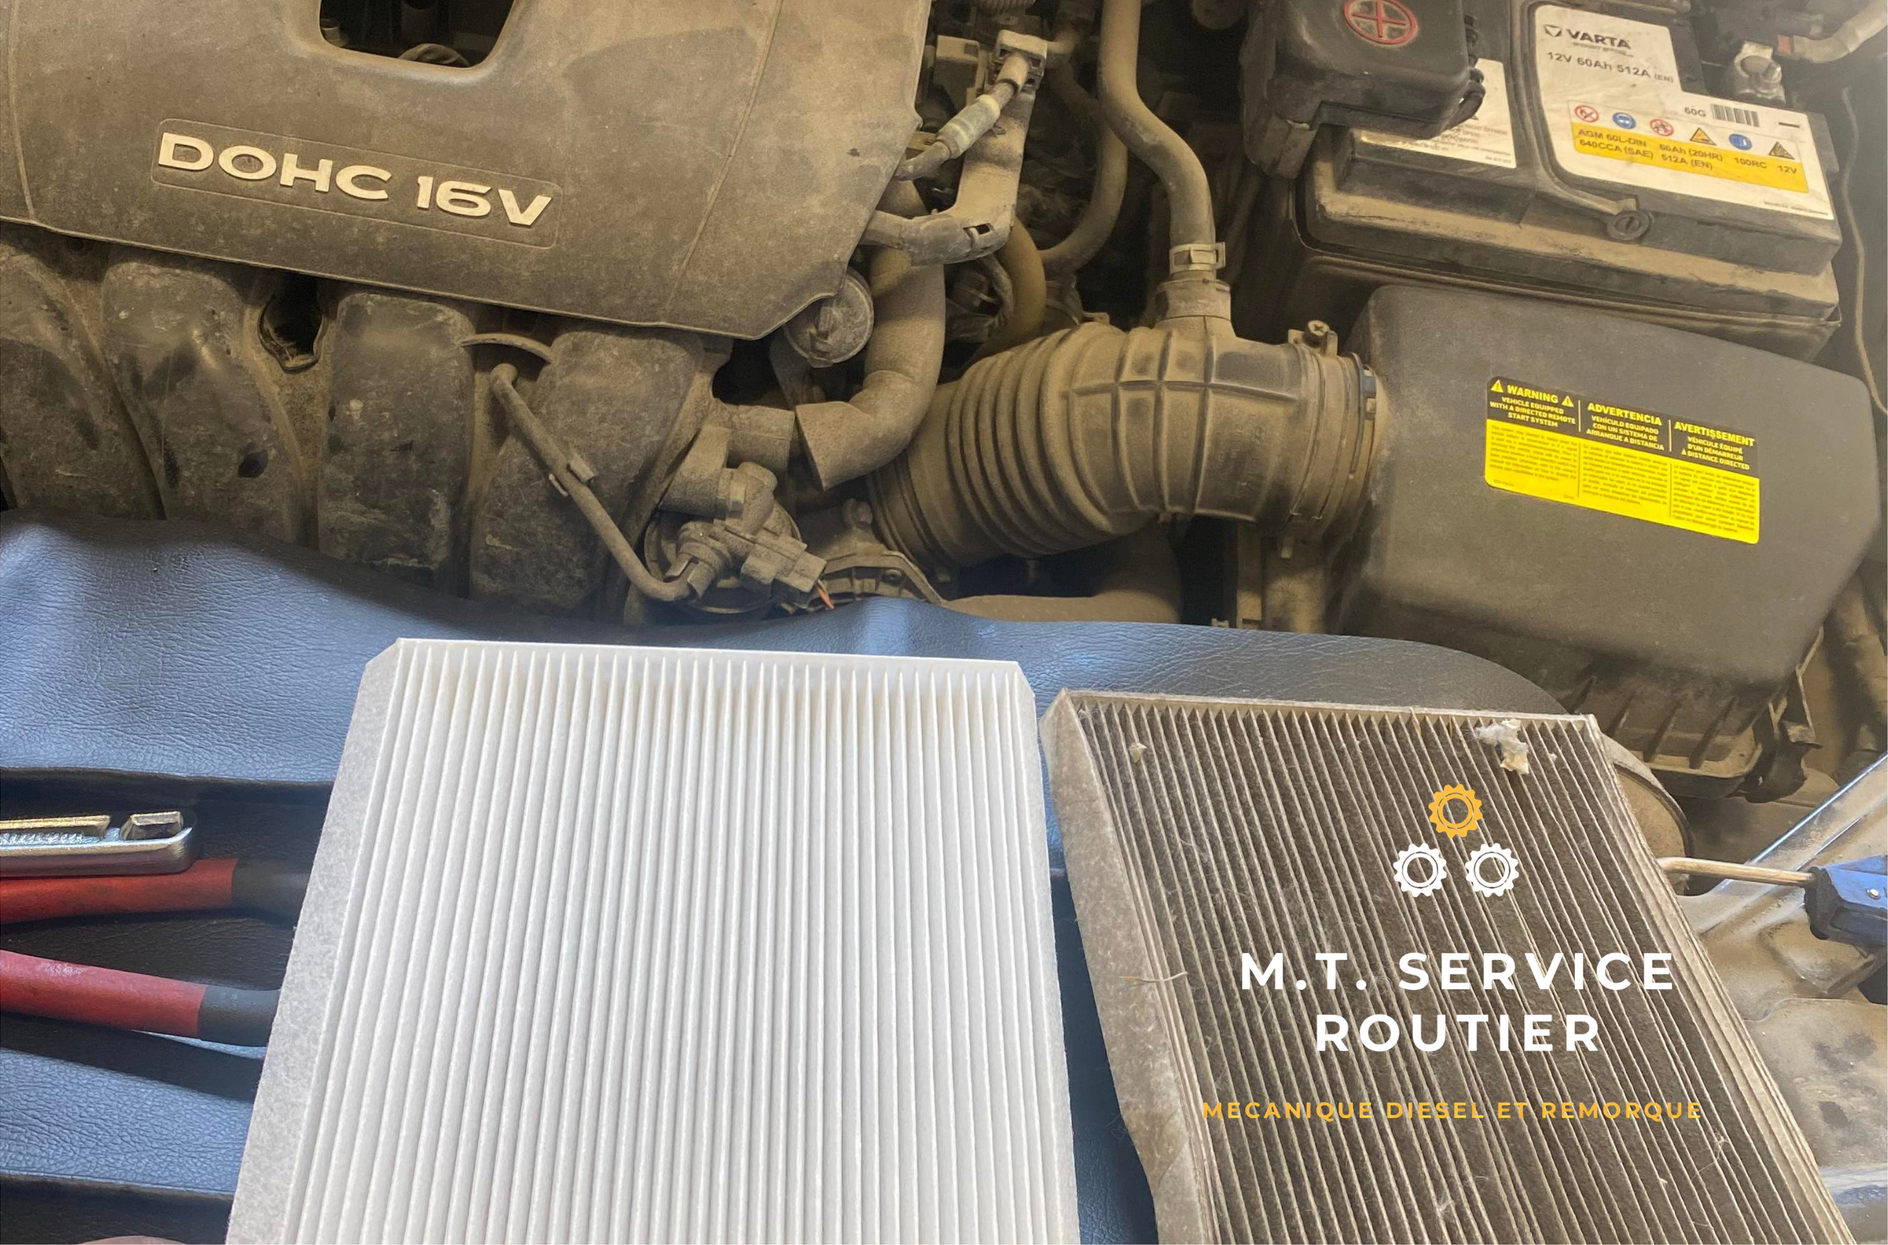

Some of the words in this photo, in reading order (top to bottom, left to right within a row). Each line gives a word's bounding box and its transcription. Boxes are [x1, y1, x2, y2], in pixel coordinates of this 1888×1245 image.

[1566, 28, 1631, 49] VARTA
[1547, 52, 1572, 63] 12V
[1577, 57, 1612, 71] 60Ah
[1617, 64, 1651, 78] 512A
[1578, 129, 1604, 139] AGM
[1606, 134, 1647, 147] 60L-DIN
[1659, 143, 1686, 154] 60Ah
[1688, 148, 1723, 162] (20HR)
[1734, 157, 1767, 169] 100RC
[1777, 165, 1798, 174] 12V
[1579, 139, 1622, 153] 640CCA
[1624, 146, 1654, 159] (SAE)
[1661, 154, 1688, 165] 512A
[1690, 159, 1713, 171] (EN)
[158, 132, 393, 200] DOHC
[417, 175, 552, 226] 16V
[1507, 384, 1559, 404] WARNING
[1490, 401, 1508, 410] WITH
[1515, 406, 1548, 418] DIRECTED
[1548, 413, 1576, 424] REMOTE
[1501, 396, 1529, 408] VEHICLE
[1530, 402, 1564, 414] EQUIPPED
[1587, 402, 1662, 426] ADVERTENCIA
[1507, 412, 1530, 422] START
[1530, 416, 1558, 427] SYSTEM
[1625, 422, 1659, 435] EQUIPADO
[1586, 428, 1623, 442] ARRANQUE
[1630, 437, 1665, 451] DISTANCIA
[1592, 423, 1606, 431] CON
[1607, 425, 1618, 434] UN
[1619, 428, 1648, 440] SISTEMA
[1648, 434, 1658, 442] DE
[1674, 421, 1755, 447] AVERTISSEMENT
[1687, 435, 1718, 450] VÉHICULE
[1687, 451, 1719, 464] DISTANCE
[1719, 458, 1750, 470] DIRECTED
[1705, 446, 1744, 461] DÉMARREUR
